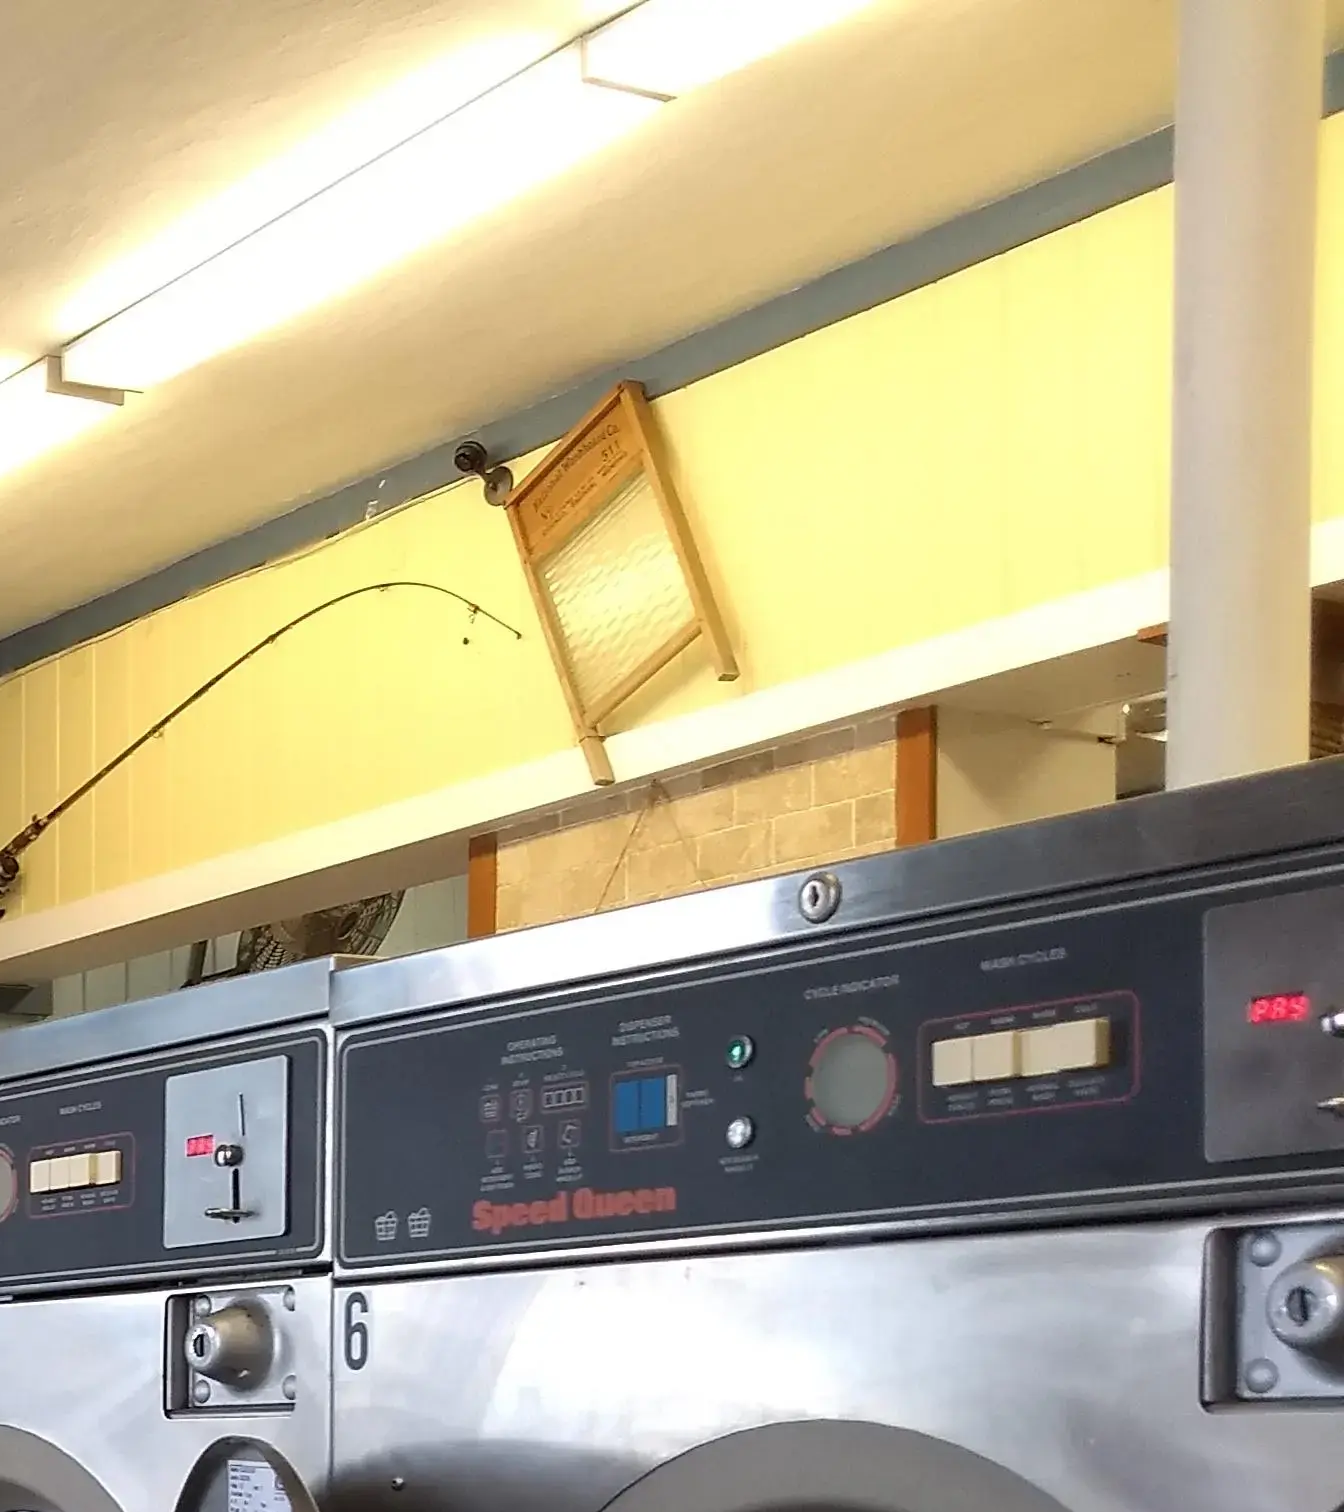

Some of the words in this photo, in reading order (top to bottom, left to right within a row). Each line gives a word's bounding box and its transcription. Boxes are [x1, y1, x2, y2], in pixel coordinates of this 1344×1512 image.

[980, 956, 1013, 971] WASH
[1013, 947, 1067, 966] CYCLES
[803, 985, 838, 1000] CYCLE
[472, 1190, 568, 1235] Speed
[573, 1187, 677, 1219] Queen
[345, 1291, 368, 1370] 6
